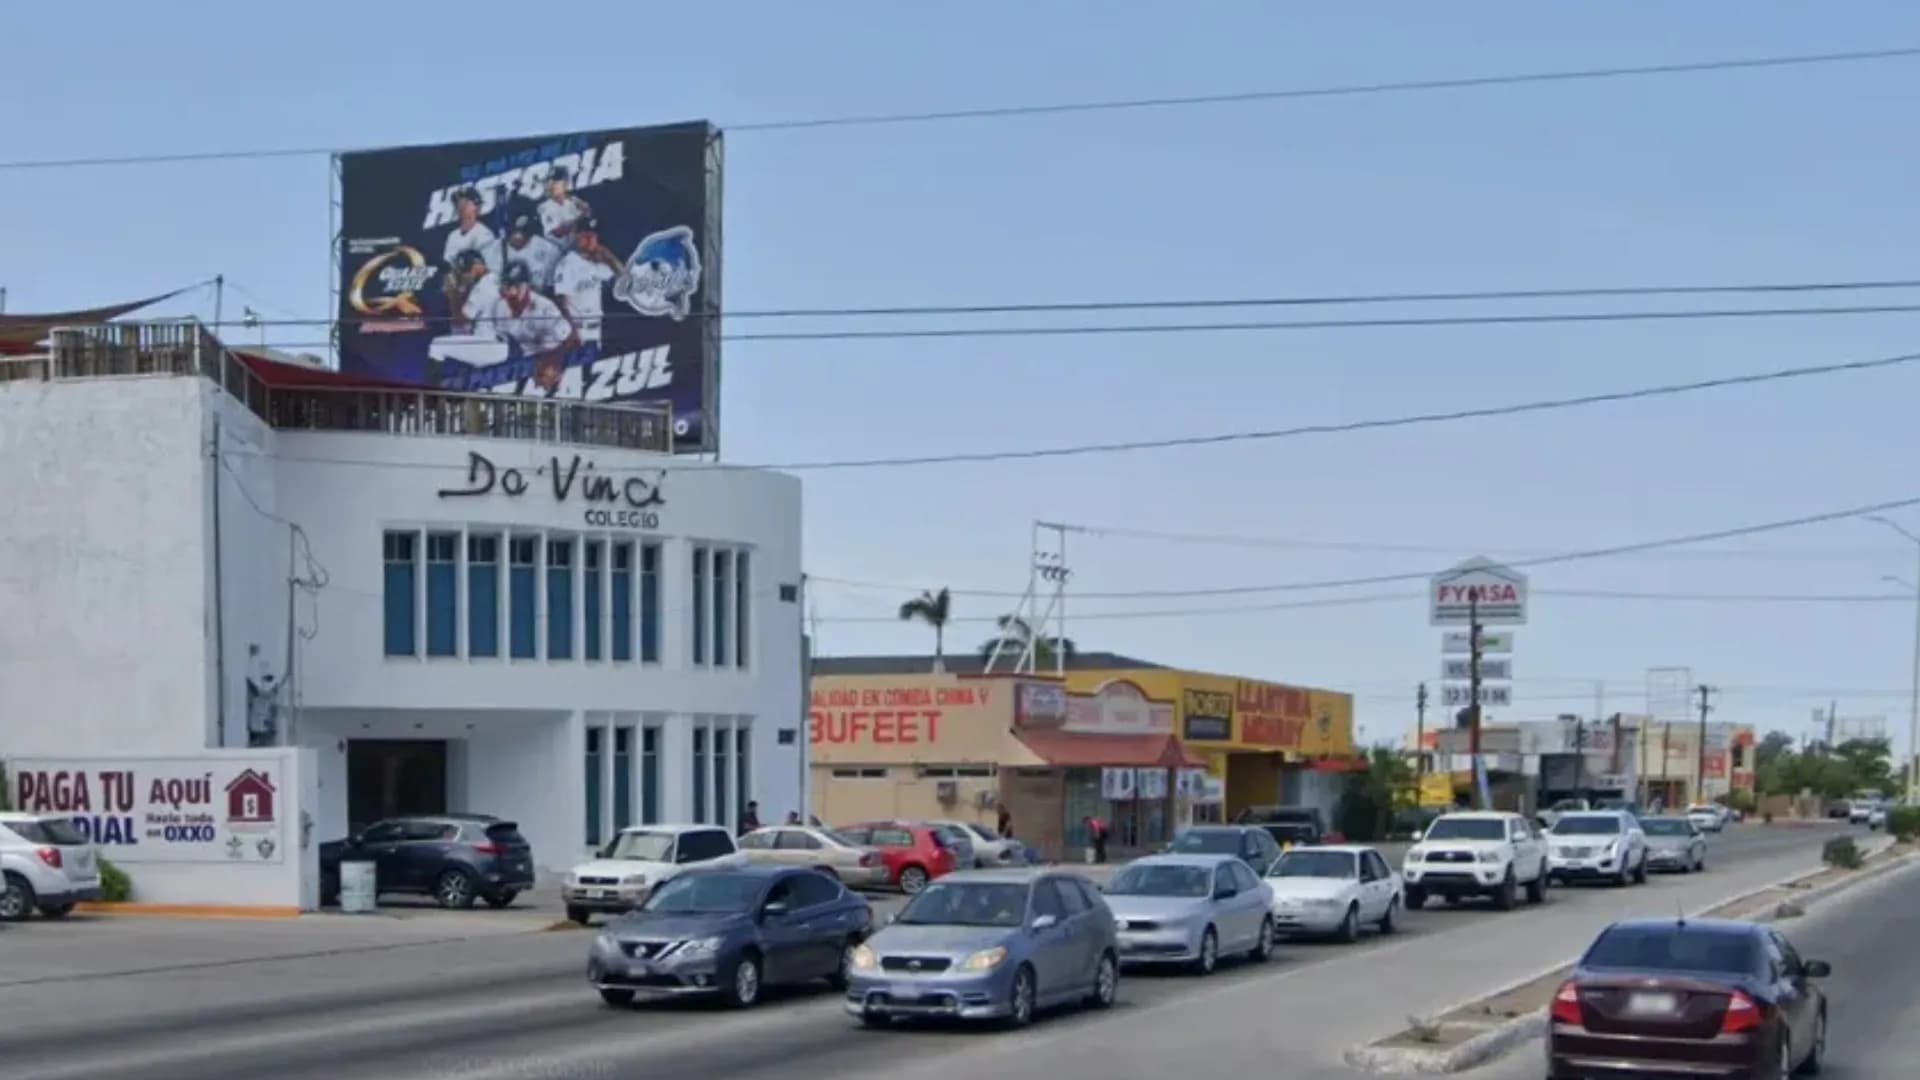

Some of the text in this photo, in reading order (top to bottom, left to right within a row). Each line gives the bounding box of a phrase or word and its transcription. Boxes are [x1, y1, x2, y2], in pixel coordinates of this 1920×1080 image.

[553, 344, 673, 400] AZUL
[584, 508, 659, 529] COLEGIO
[1438, 584, 1517, 602] FYMSA
[863, 690, 881, 706] EN
[18, 771, 213, 812] PAGA TU AQUÍ
[73, 816, 138, 844] DIAL
[164, 825, 215, 842] OXXO
